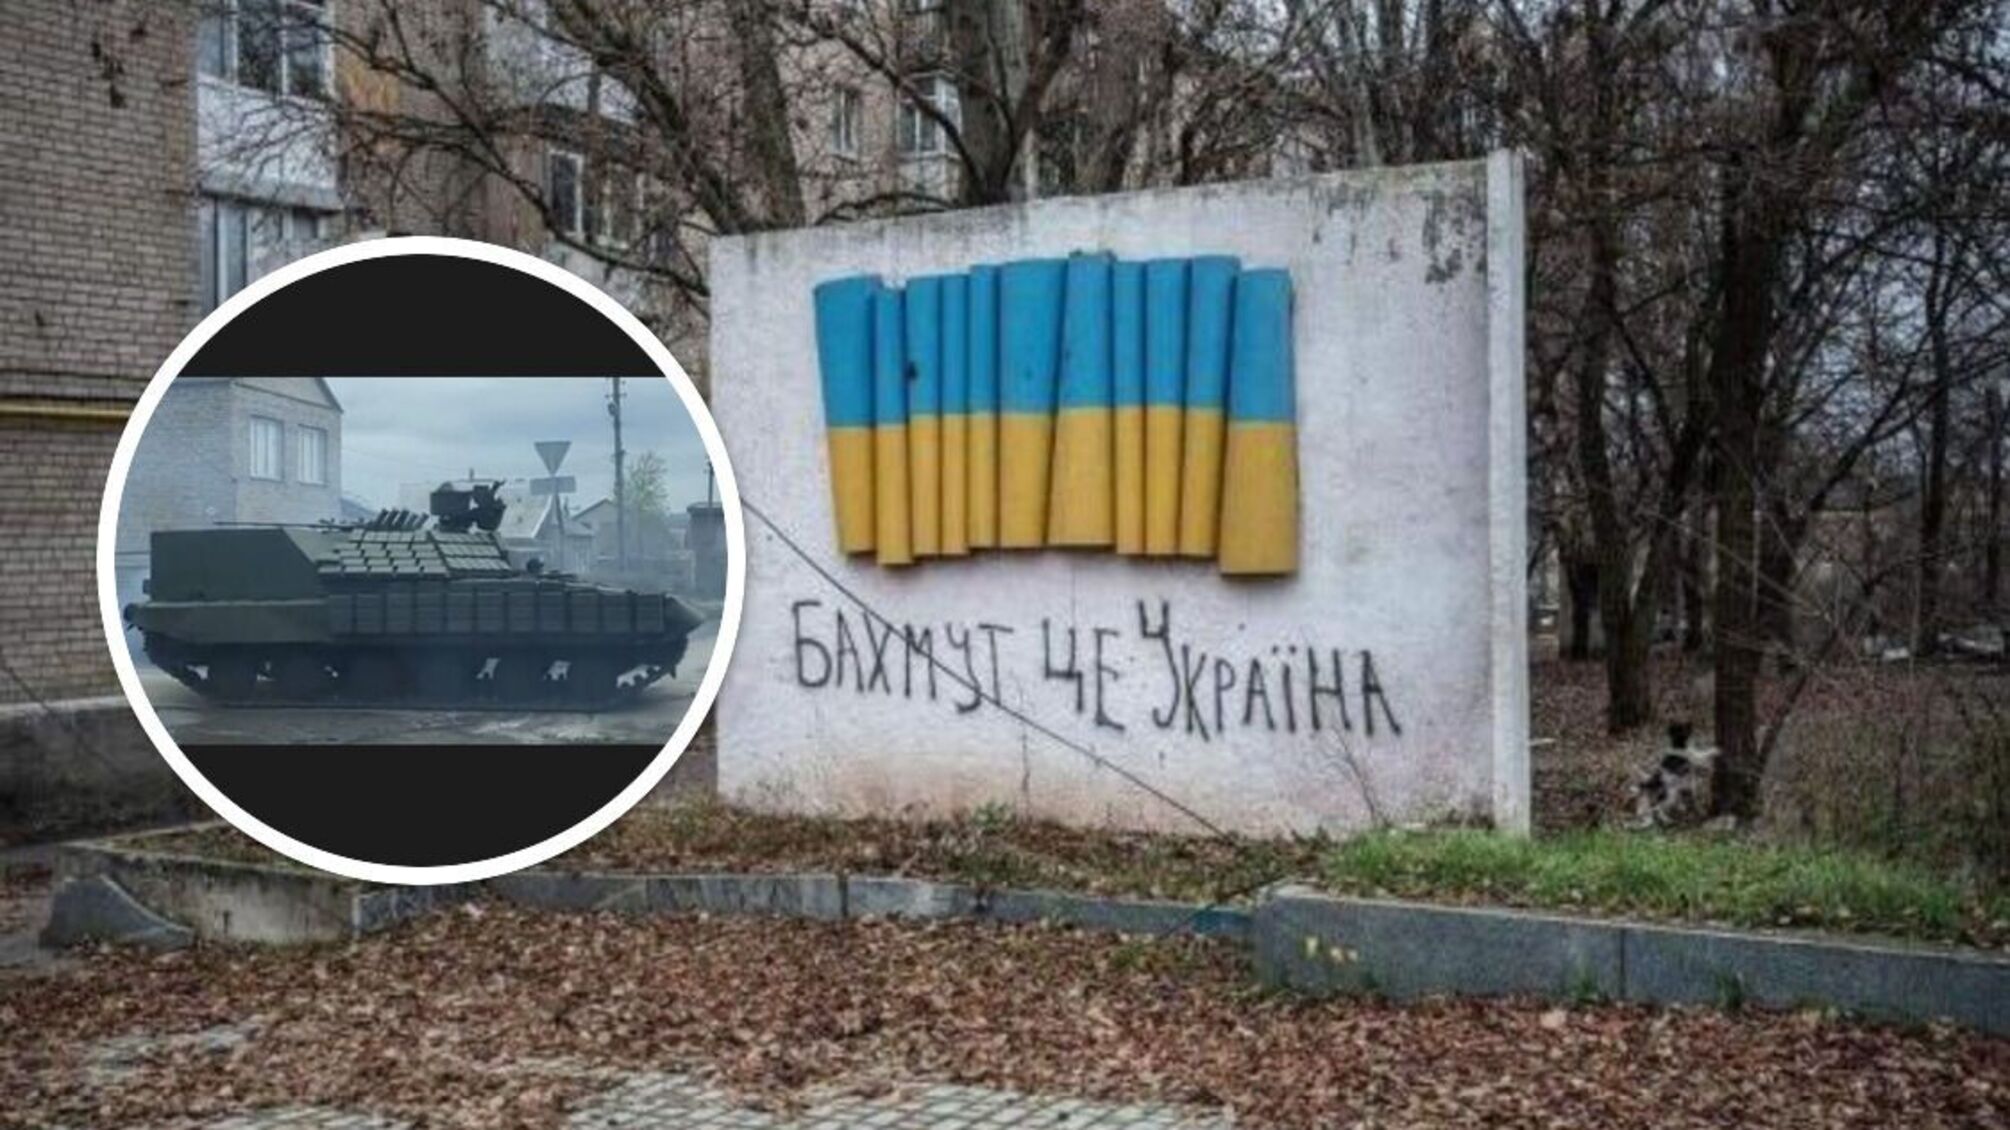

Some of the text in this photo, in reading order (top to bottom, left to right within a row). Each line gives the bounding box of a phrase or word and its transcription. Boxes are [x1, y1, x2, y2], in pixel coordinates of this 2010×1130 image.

[791, 600, 1402, 742] БАХМУТ ЦЕ УКРАЇНА
